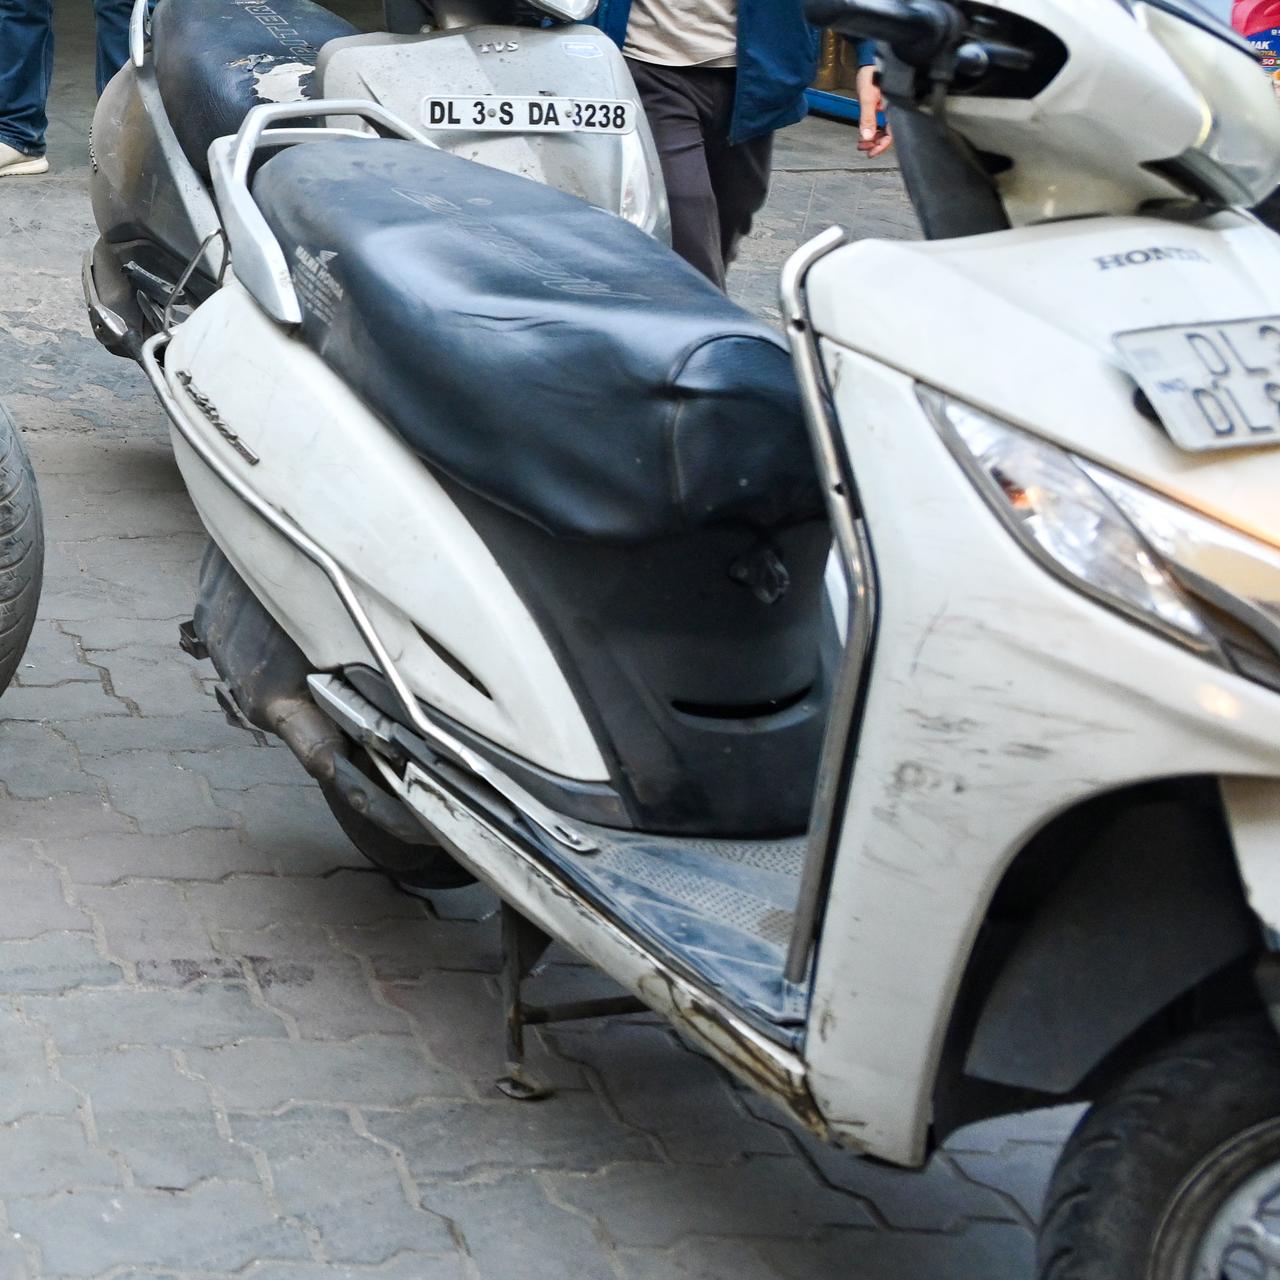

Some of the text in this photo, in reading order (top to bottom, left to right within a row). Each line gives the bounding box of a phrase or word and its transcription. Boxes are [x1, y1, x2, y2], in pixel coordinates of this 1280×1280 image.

[478, 40, 521, 54] TVS
[430, 101, 461, 125] DL
[528, 102, 560, 126] DA
[572, 104, 626, 129] 3238
